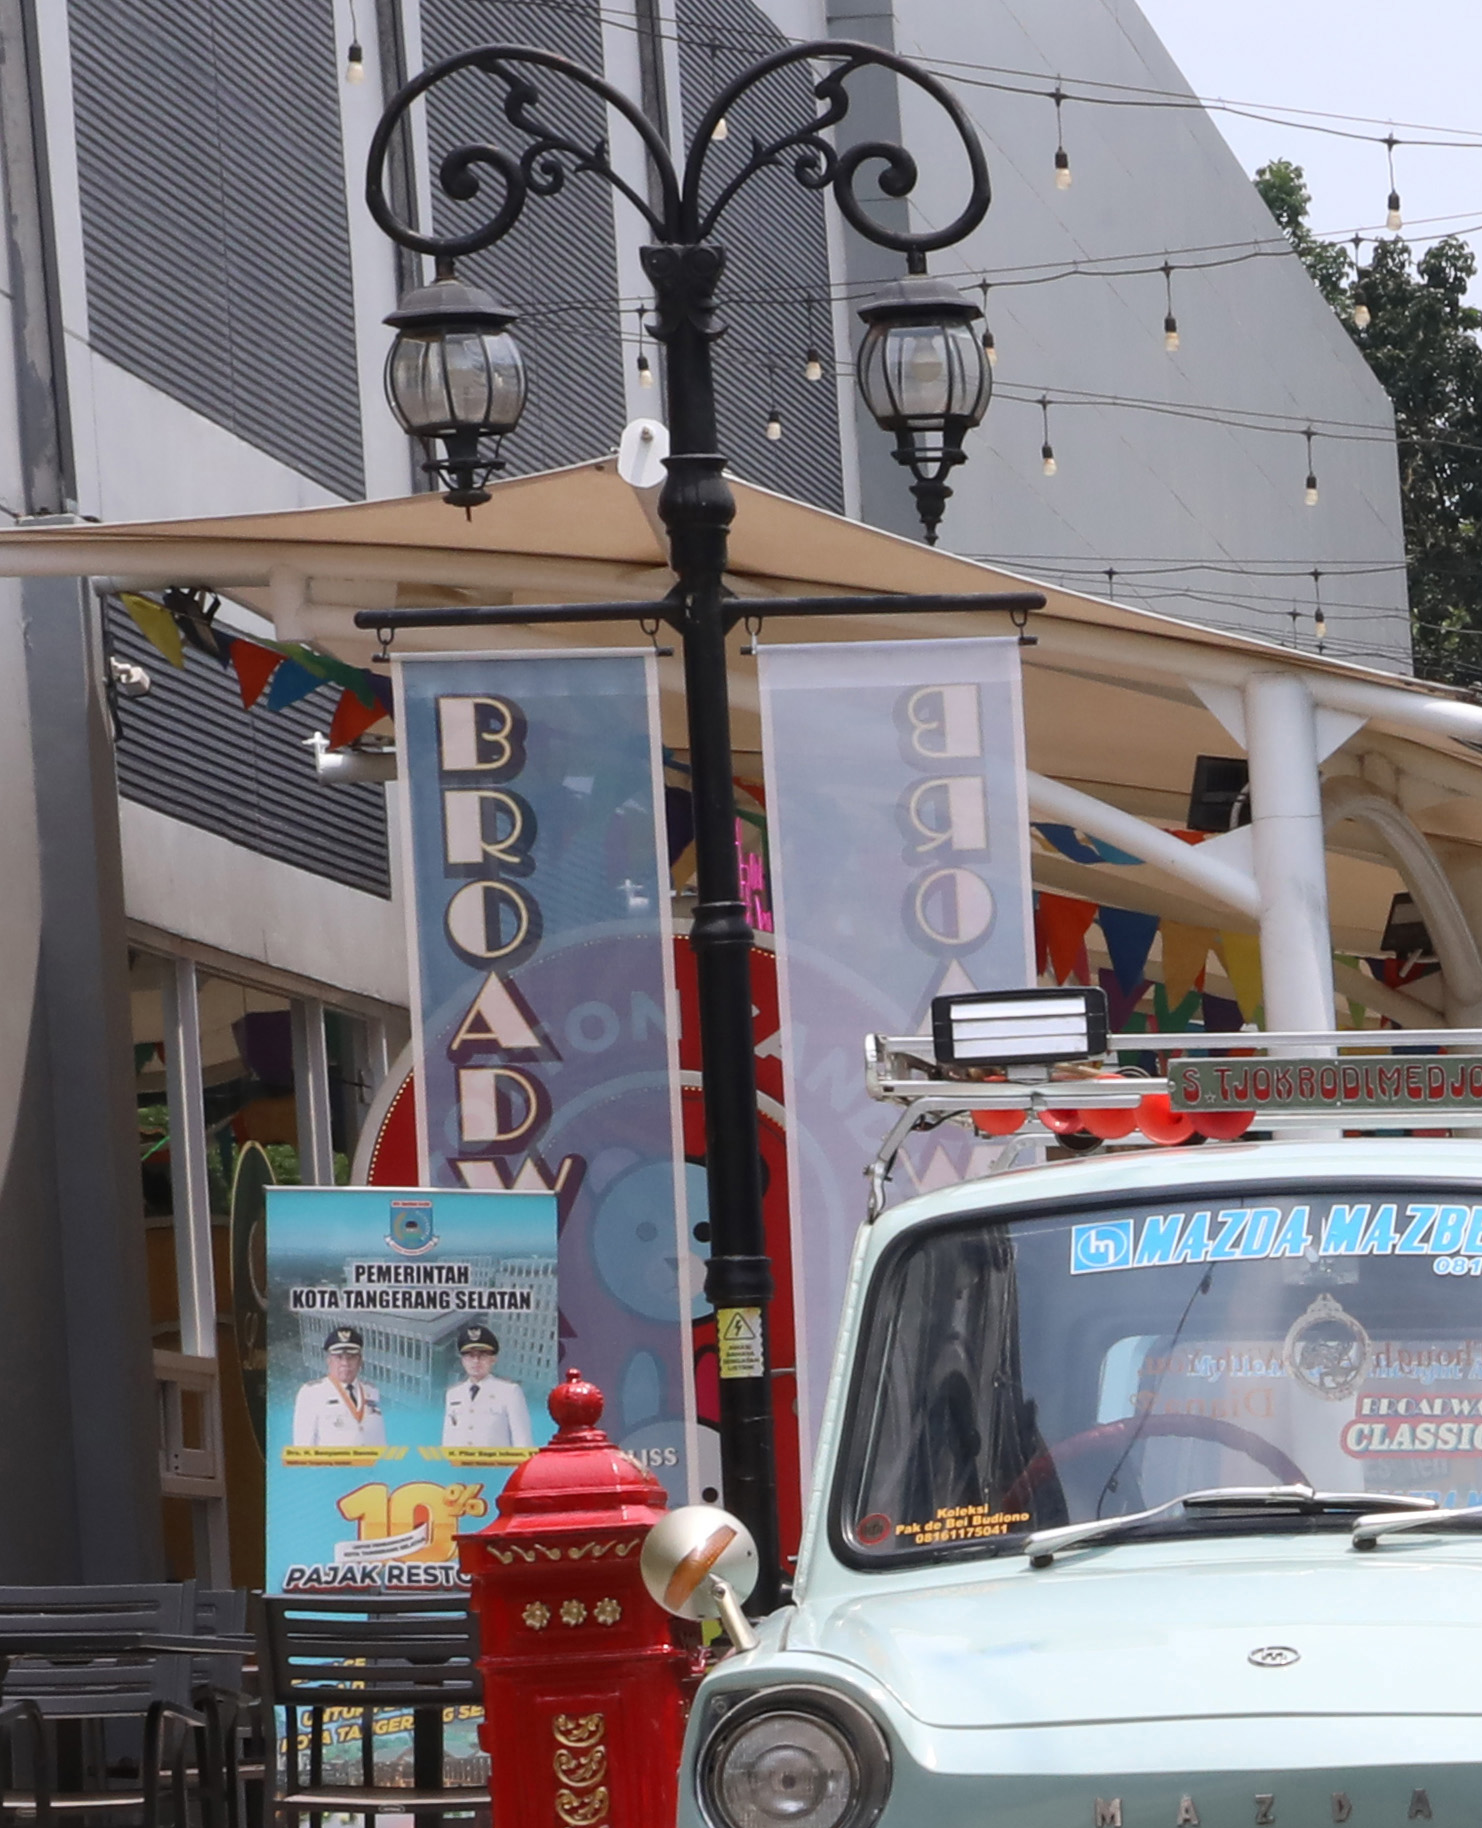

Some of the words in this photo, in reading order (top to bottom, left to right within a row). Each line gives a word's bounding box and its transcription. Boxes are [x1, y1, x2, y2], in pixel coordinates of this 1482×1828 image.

[1134, 1207, 1310, 1268] MAZDA
[354, 1264, 469, 1284] PEMERINTAH
[292, 1289, 339, 1309] KOTA
[343, 1290, 449, 1310] TANGERANG
[455, 1290, 531, 1310] SELATAN
[937, 1503, 989, 1519] Koleksi
[895, 1523, 921, 1536] Pak
[924, 1520, 941, 1531] de
[946, 1517, 968, 1529] Bei
[972, 1512, 1030, 1526] Budiono
[915, 1524, 1008, 1545] 08161175041
[285, 1566, 381, 1587] PAJAK
[1095, 1788, 1432, 1828] MAZDA
